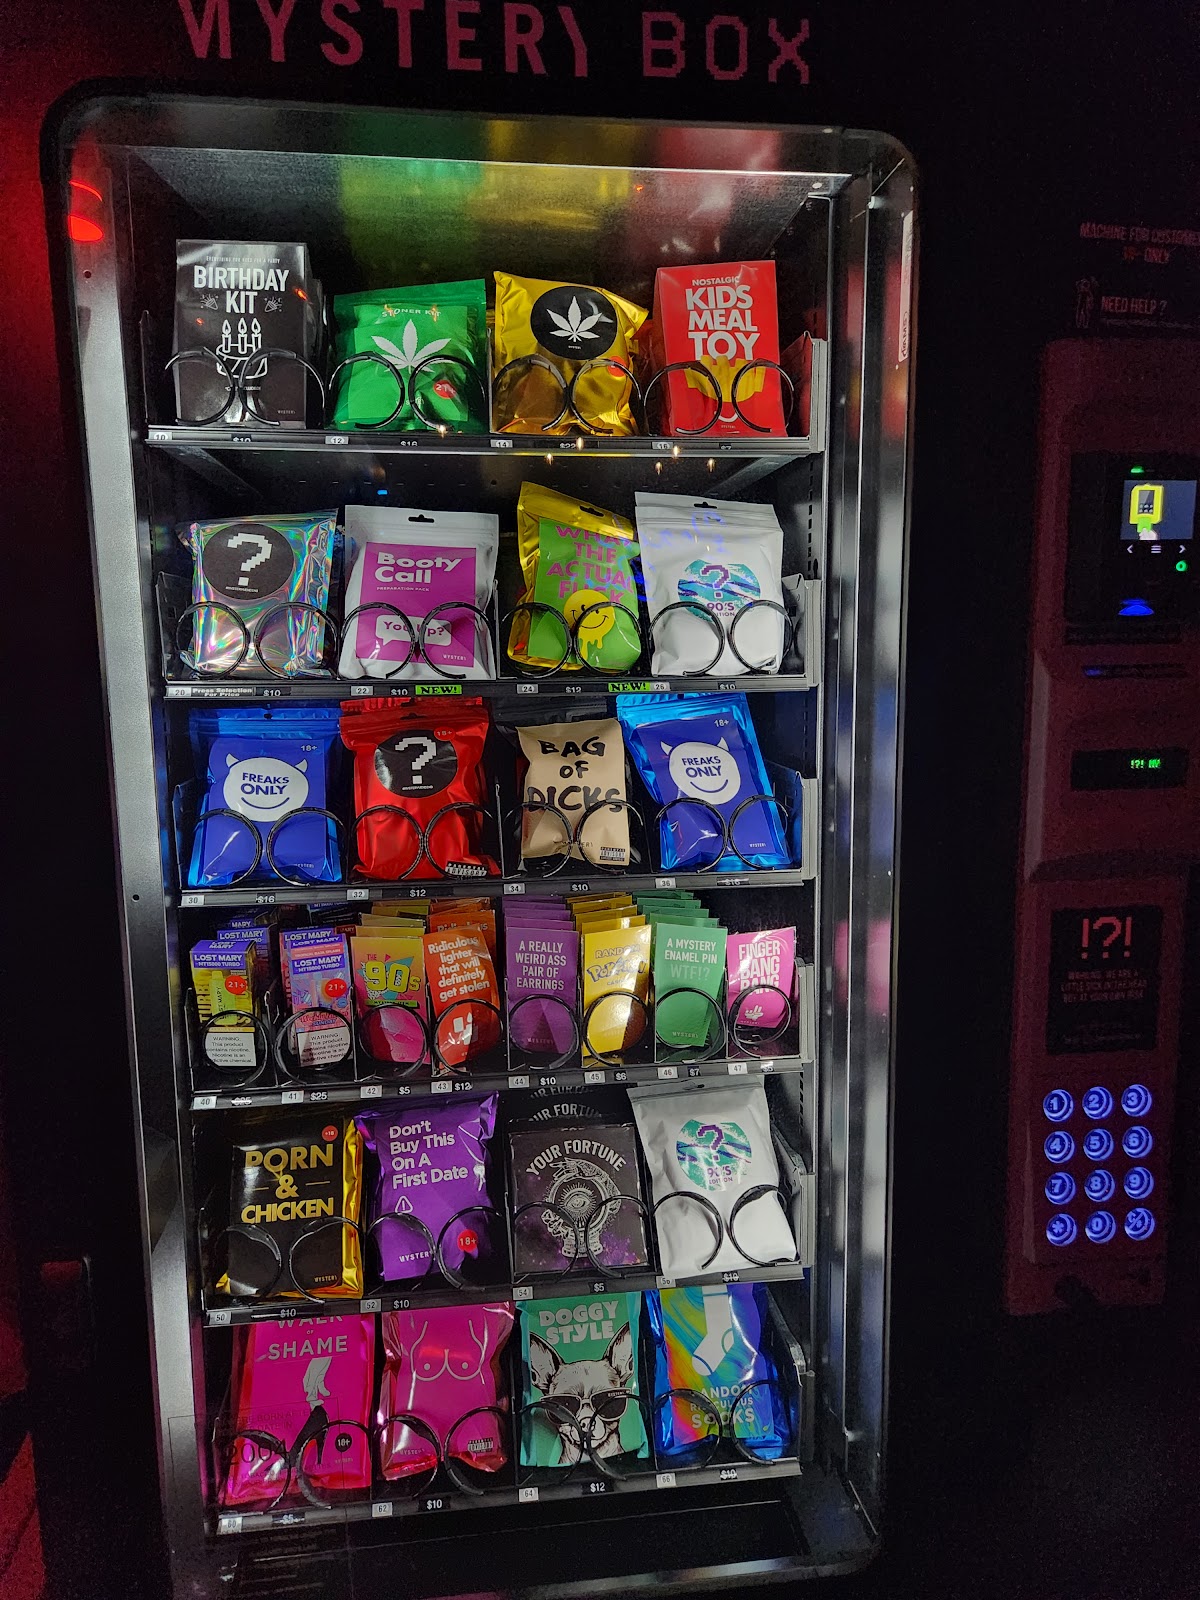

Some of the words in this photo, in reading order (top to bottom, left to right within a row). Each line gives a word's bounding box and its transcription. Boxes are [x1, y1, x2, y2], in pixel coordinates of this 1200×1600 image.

[642, 11, 809, 84] BOX
[193, 265, 289, 292] BIRTHDAY
[692, 275, 740, 286] NOSTALGIC
[225, 290, 258, 314] KIT
[685, 285, 753, 310] KIDS
[1102, 296, 1128, 313] NEED
[688, 309, 758, 332] MEAL
[688, 332, 761, 361] TOY
[227, 532, 272, 586] ?
[574, 541, 617, 564] THE
[377, 552, 462, 572] Booty
[374, 566, 431, 583] Call
[547, 561, 634, 593] ACTUAL
[706, 602, 735, 611] 90'S
[263, 689, 281, 697] $10
[420, 685, 458, 694] NEW!
[612, 682, 647, 691] NEW!
[714, 719, 729, 727] 18+
[537, 736, 606, 757] BAG
[395, 737, 436, 784] ?
[682, 756, 721, 766] FREAKS
[559, 760, 589, 779] OF
[685, 765, 722, 778] ONLY
[241, 772, 290, 785] FREAKS
[240, 783, 288, 796] ONLY
[527, 785, 623, 812] DICKS
[409, 889, 426, 897] $12
[571, 883, 589, 891] $10
[219, 932, 240, 940] LOST
[242, 930, 264, 938] MARY
[284, 932, 307, 941] LOST
[308, 930, 331, 939] MARY
[1081, 917, 1133, 960] !?!
[428, 937, 479, 954] Ridiculous
[519, 941, 526, 951] A
[529, 941, 563, 953] REALLY
[667, 938, 673, 947] A
[676, 939, 716, 951] MYSTERY
[738, 940, 780, 960] FINGER
[294, 959, 318, 967] LOST
[318, 955, 342, 964] MARY
[440, 949, 473, 964] lighter
[515, 953, 546, 965] WEIRD
[547, 955, 567, 966] ASS
[664, 951, 700, 963] ENAMEL
[702, 953, 718, 964] PIN
[438, 963, 460, 975] that
[462, 956, 480, 969] will
[522, 967, 544, 977] PAIR
[546, 967, 559, 978] OF
[670, 963, 710, 980] WTF!?
[740, 956, 780, 980] BANG
[366, 961, 421, 994] 90s
[438, 968, 486, 987] definitely
[516, 978, 564, 990] EARRINGS
[327, 983, 345, 991] 21+
[440, 988, 457, 1002] get
[459, 980, 490, 994] stolen
[690, 1068, 700, 1077] $7
[454, 1082, 471, 1091] $12
[540, 1077, 557, 1086] $10
[310, 1092, 328, 1101] $25
[399, 1086, 411, 1095] $5
[1050, 1096, 1058, 1110] 1
[1088, 1094, 1100, 1108] 2
[1127, 1092, 1138, 1106] 3
[389, 1120, 432, 1139] Don't
[390, 1140, 420, 1155] Buy
[423, 1132, 455, 1149] This
[1050, 1138, 1061, 1151] 4
[1089, 1136, 1100, 1149] 5
[1128, 1133, 1139, 1147] 6
[245, 1144, 334, 1173] PORN
[391, 1157, 415, 1171] On
[418, 1153, 432, 1166] A
[526, 1144, 562, 1176] YOUR
[563, 1139, 627, 1172] FORTUNE
[392, 1172, 427, 1189] First
[430, 1164, 468, 1183] Date
[1051, 1179, 1062, 1193] 7
[1090, 1176, 1101, 1190] 8
[1129, 1174, 1141, 1187] 9
[275, 1174, 299, 1199] &
[241, 1197, 334, 1224] CHICKEN
[1092, 1218, 1103, 1231] 0
[459, 1237, 477, 1246] 18+
[519, 1289, 528, 1297] 54
[593, 1283, 605, 1292] $5
[366, 1301, 375, 1309] 52
[393, 1300, 410, 1309] $10
[280, 1308, 297, 1318] $10
[539, 1300, 619, 1326] DOGGY
[546, 1320, 615, 1345] STYLE
[268, 1335, 348, 1360] SHAME
[691, 1408, 755, 1429] SOCKS
[337, 1438, 350, 1447] 18+
[662, 1475, 671, 1483] 66
[721, 1470, 737, 1479] $10
[590, 1482, 605, 1492] $12
[427, 1500, 443, 1509] $10
[227, 1520, 237, 1528] 60
